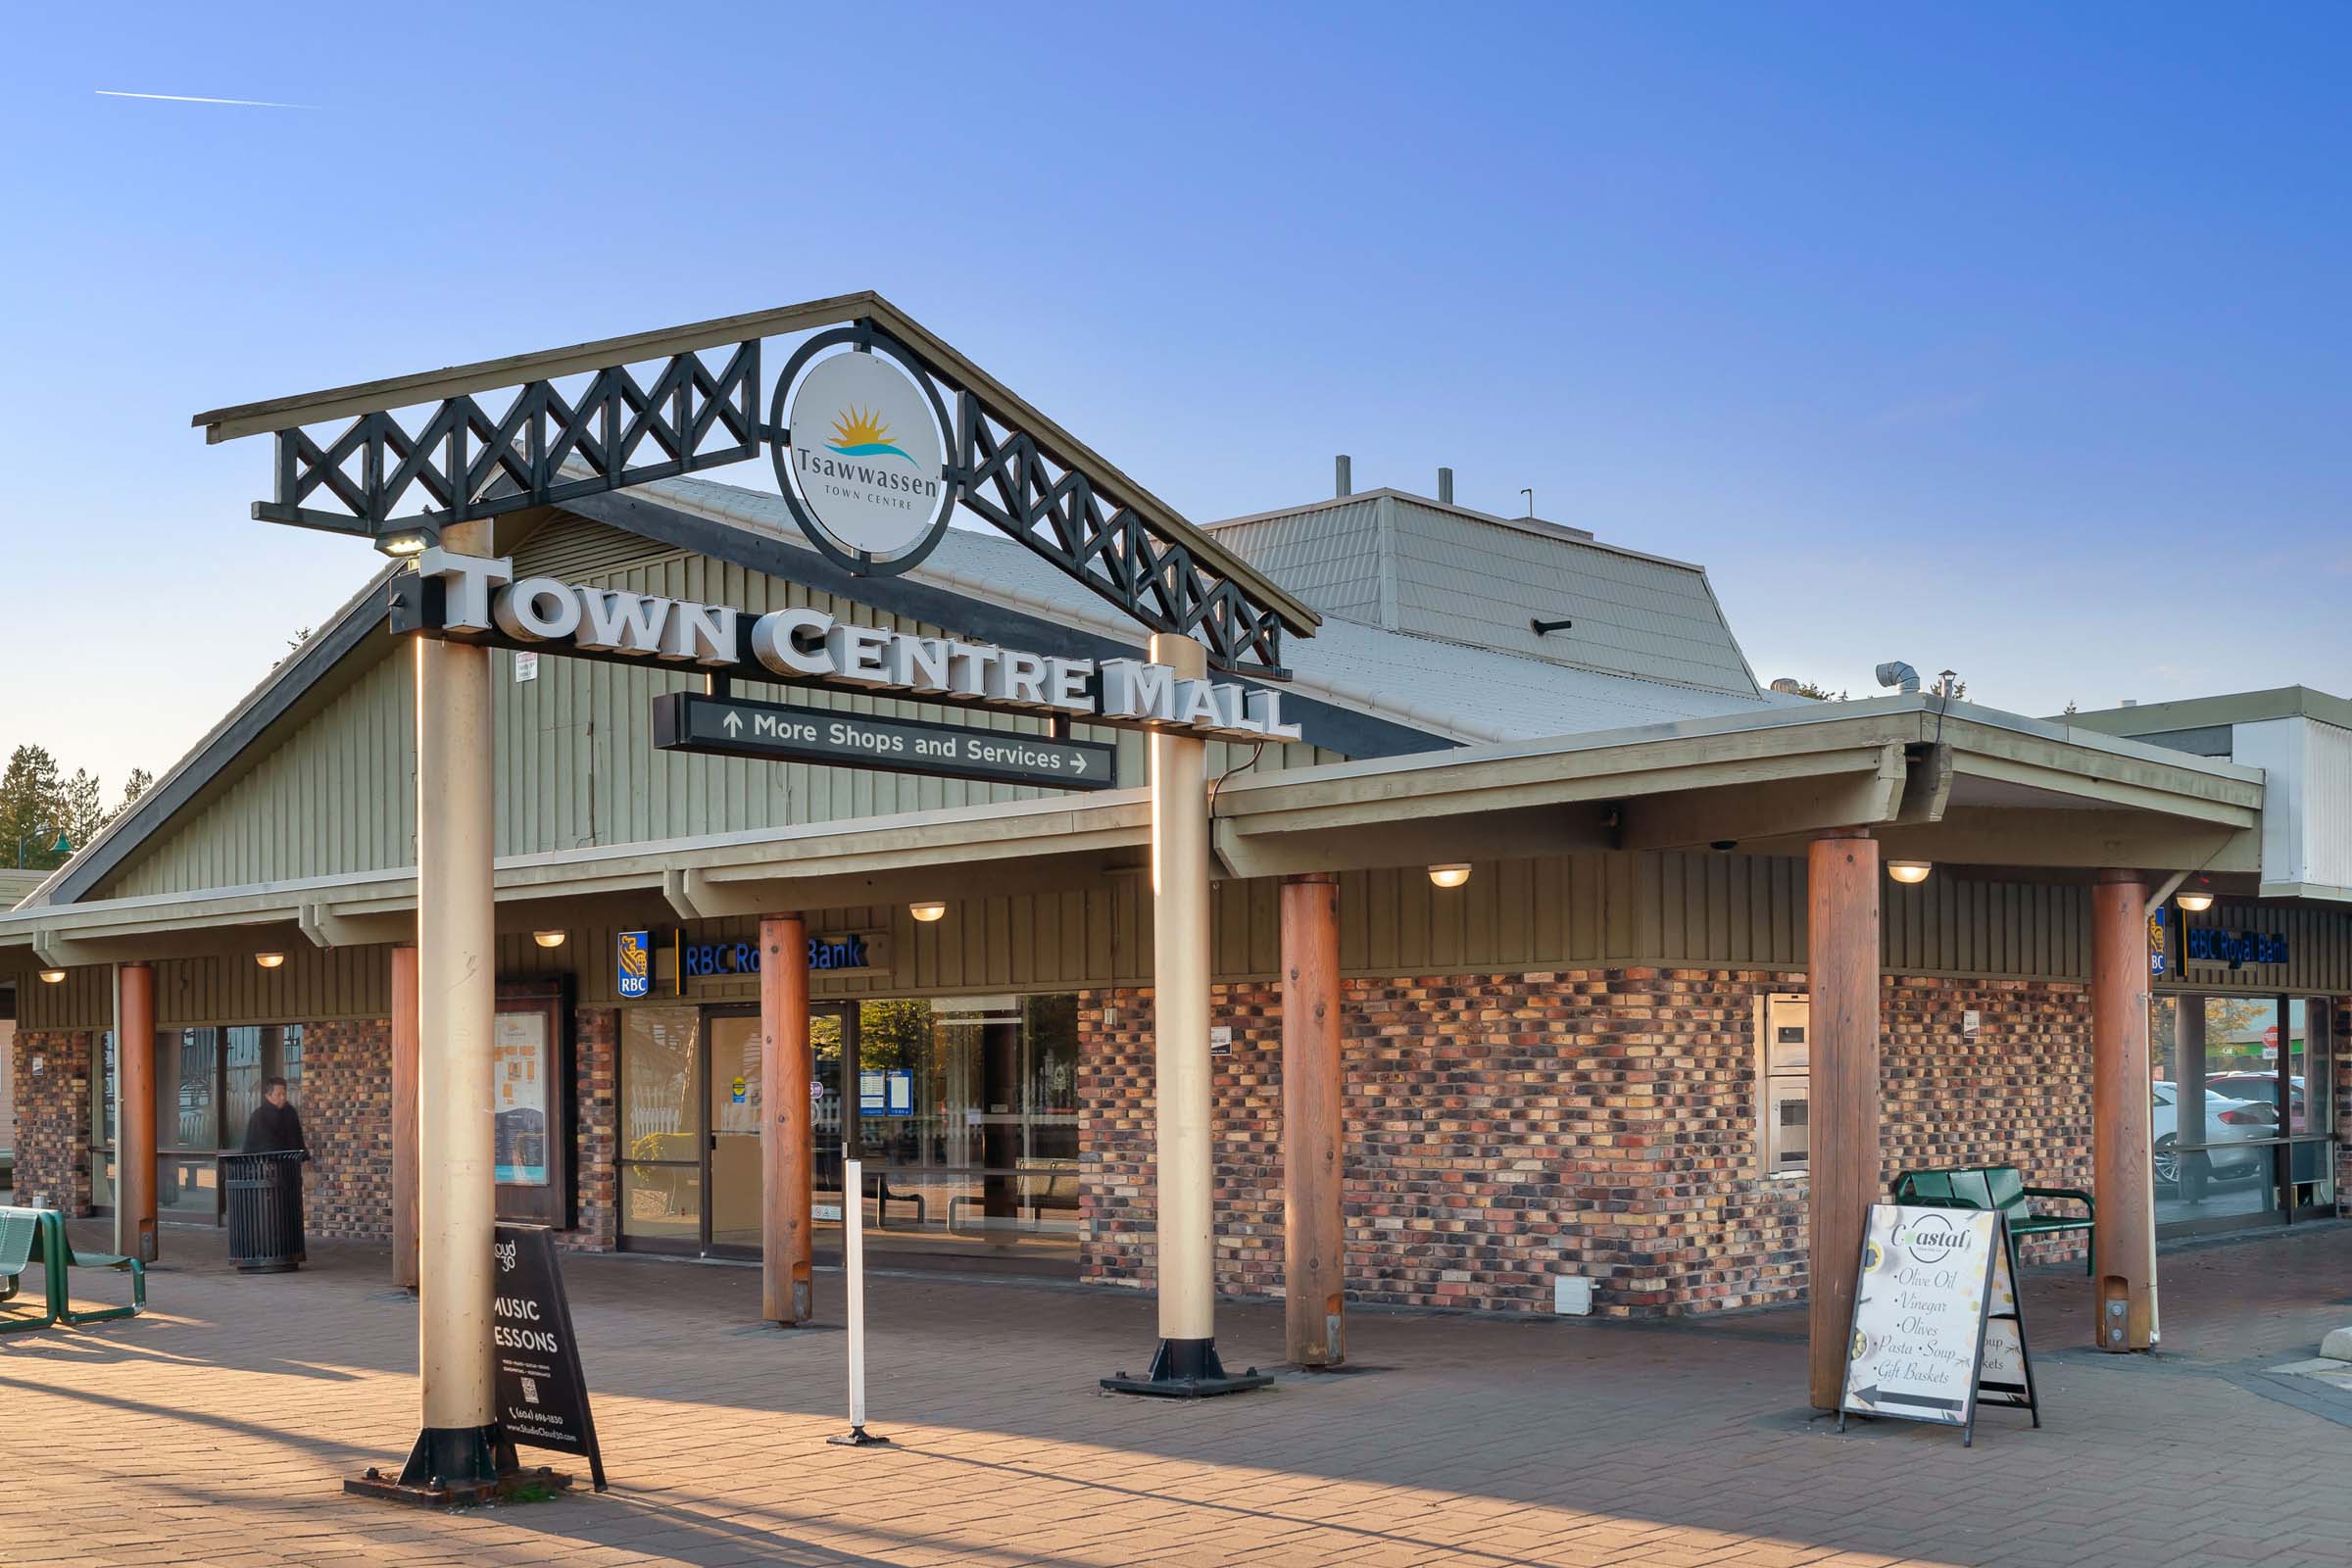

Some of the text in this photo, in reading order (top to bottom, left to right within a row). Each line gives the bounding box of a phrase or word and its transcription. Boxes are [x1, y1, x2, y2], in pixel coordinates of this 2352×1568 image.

[797, 447, 937, 498] Tsawwassen
[824, 484, 912, 511] TOWN CENTRE
[419, 546, 1302, 742] TOWN CENTRE MALL
[754, 713, 1061, 769] More Shops and Services
[686, 943, 729, 976] RBC
[808, 933, 862, 968] Bank
[2189, 927, 2217, 959] RBC
[2151, 954, 2165, 970] BC
[621, 976, 647, 992] RBC
[501, 1255, 515, 1272] 30
[1898, 1267, 1958, 1290] Olive Oil
[1901, 1290, 1948, 1316] Vinegar
[494, 1325, 558, 1353] ESSONS
[1901, 1315, 1938, 1337] Olives
[1879, 1334, 1957, 1364] Pasta Soup
[1877, 1358, 1951, 1385] Gift Baskets
